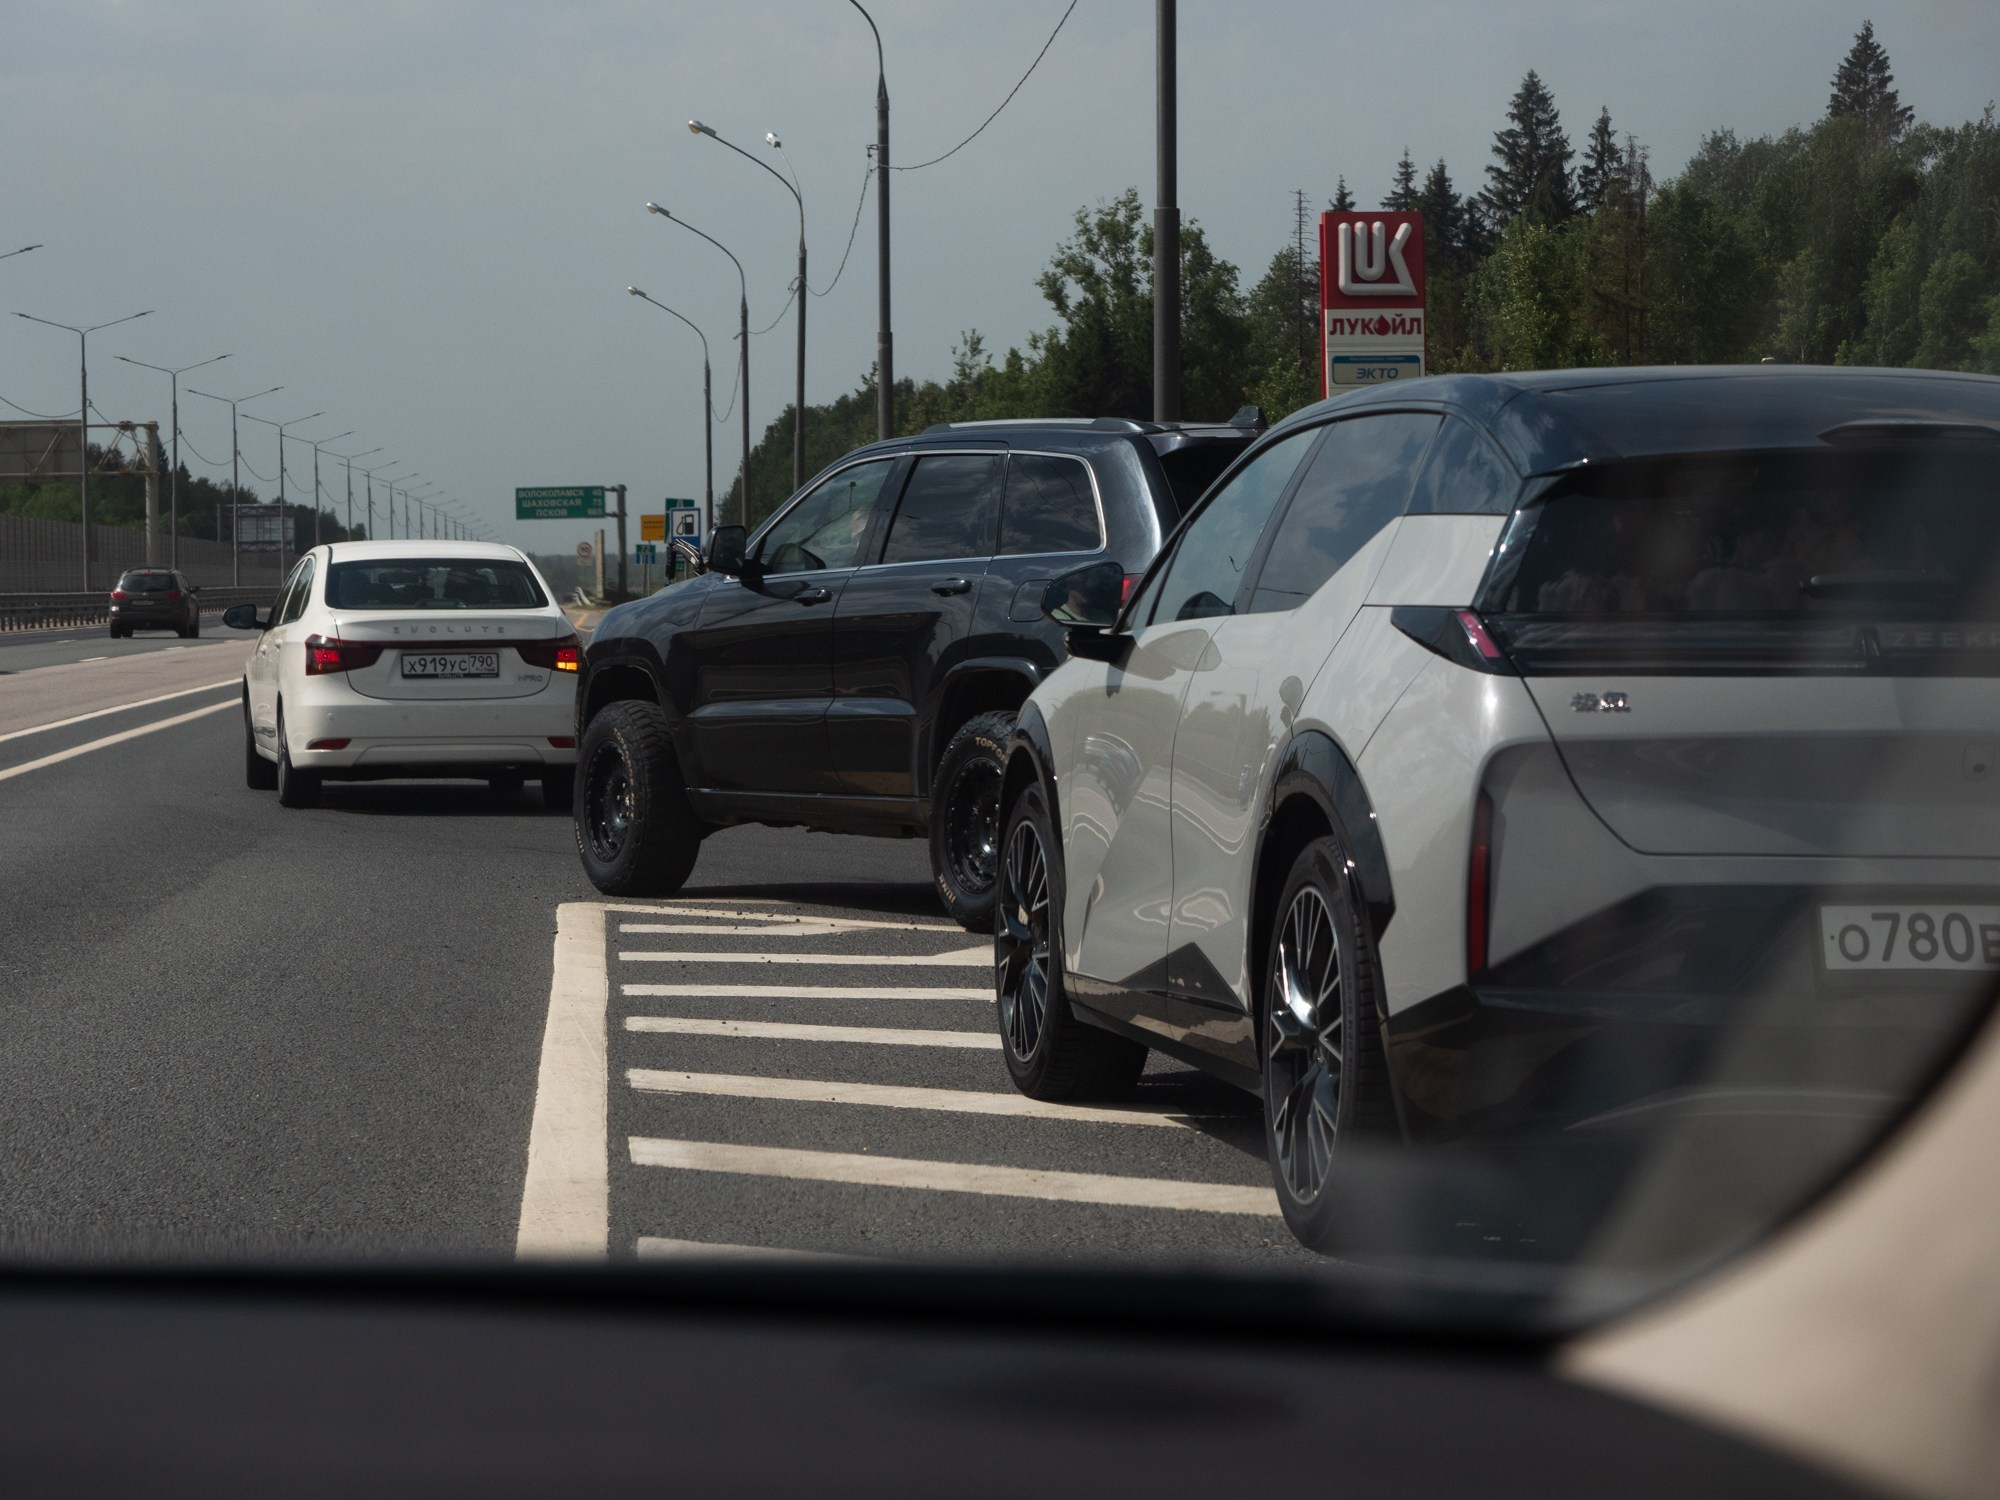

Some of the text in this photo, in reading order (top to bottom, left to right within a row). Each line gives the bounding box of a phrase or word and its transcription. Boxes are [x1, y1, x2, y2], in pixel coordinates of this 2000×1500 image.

[1356, 367, 1399, 379] ЭКТО
[518, 488, 584, 498] ВОЛОКОЛАМСК
[522, 498, 582, 507] ШАХОВСКАЯ
[536, 508, 568, 517] ПСКОВ
[470, 655, 493, 667] 790
